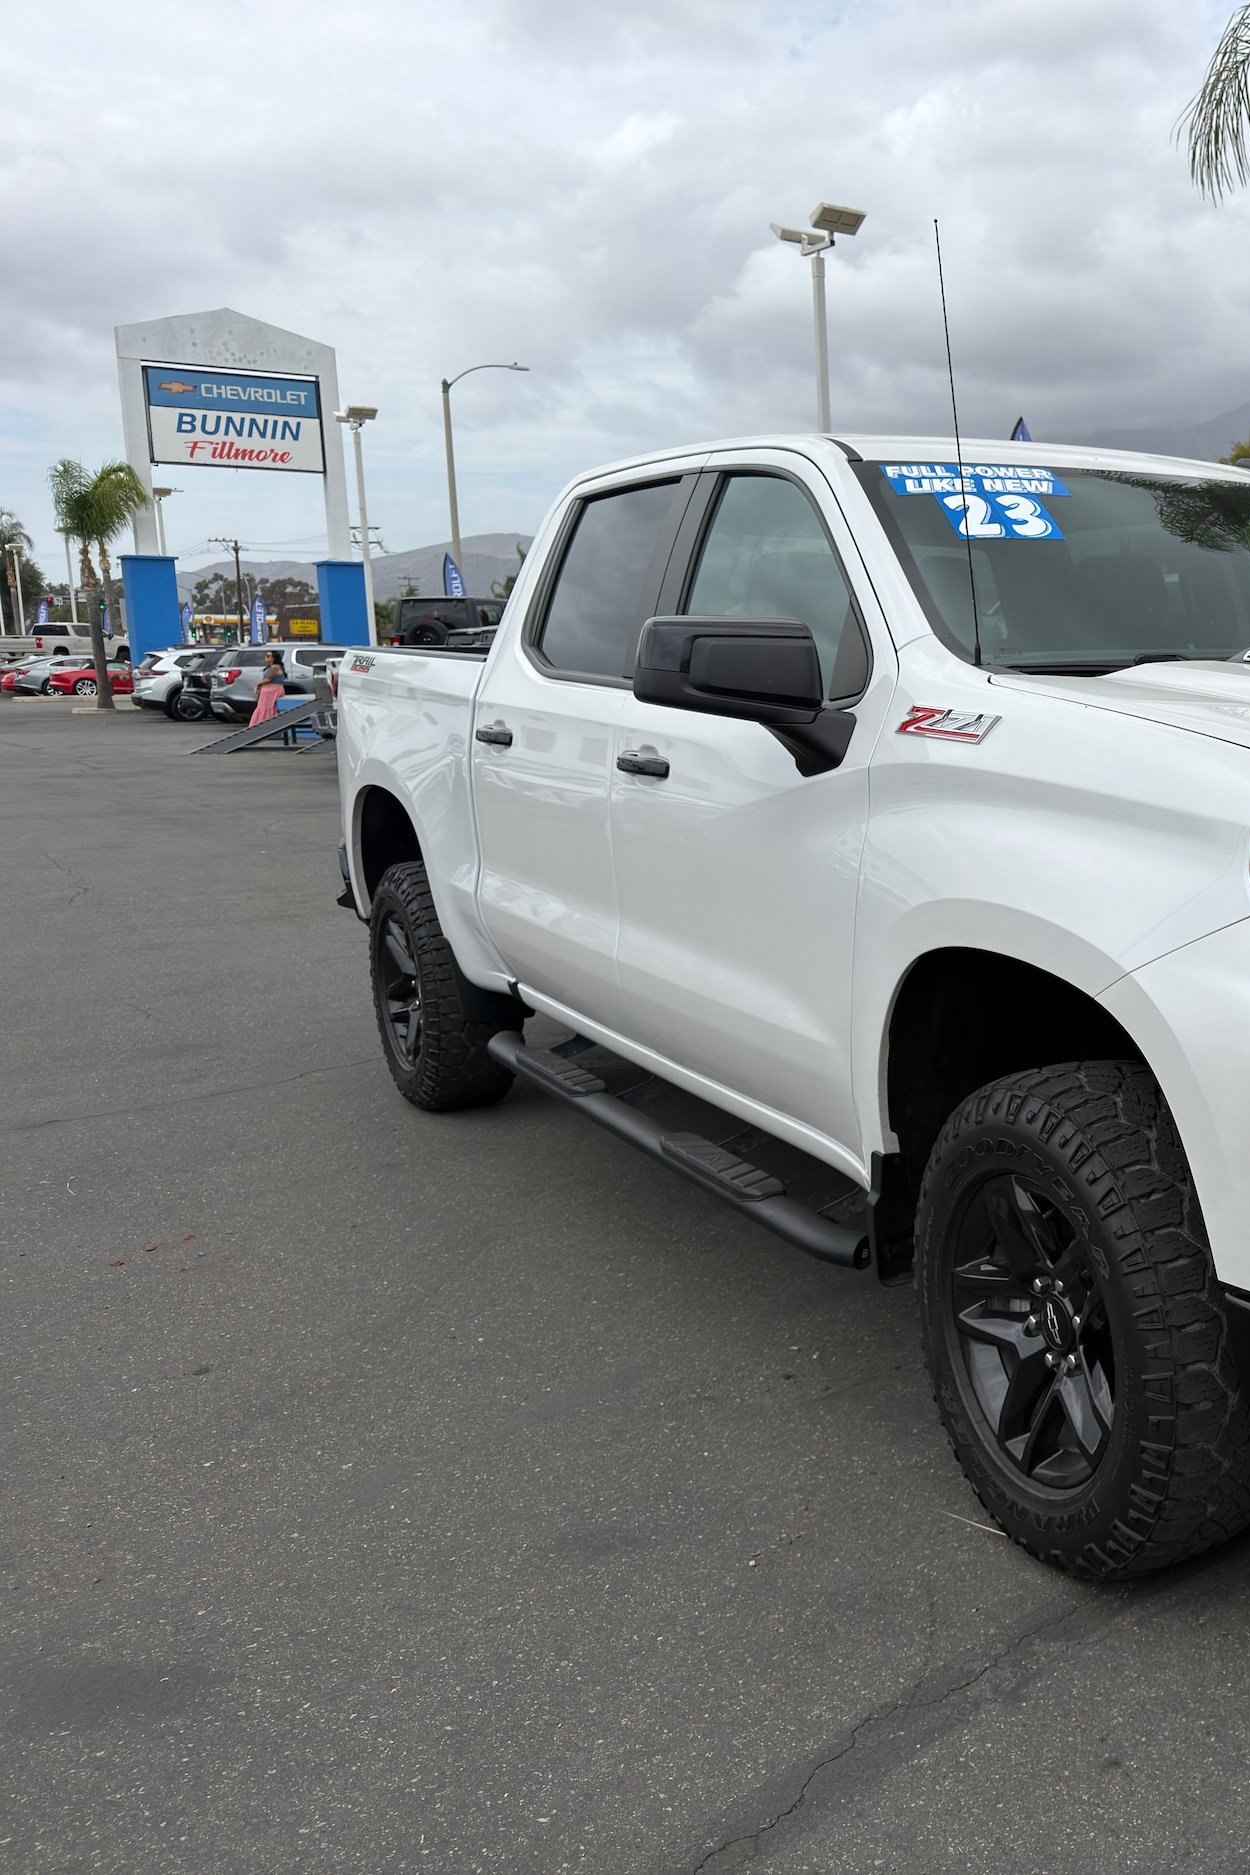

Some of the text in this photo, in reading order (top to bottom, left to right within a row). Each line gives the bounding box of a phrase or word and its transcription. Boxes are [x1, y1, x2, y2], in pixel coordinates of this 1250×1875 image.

[201, 383, 308, 405] CHEVROLET
[176, 412, 301, 441] BUNNIN
[184, 440, 293, 464] Fillmore
[884, 465, 1055, 480] FULL POWER
[905, 479, 1053, 494] LIKE NEW
[942, 494, 1053, 538] 23
[354, 655, 376, 666] TRAIL
[895, 704, 1002, 745] Z71
